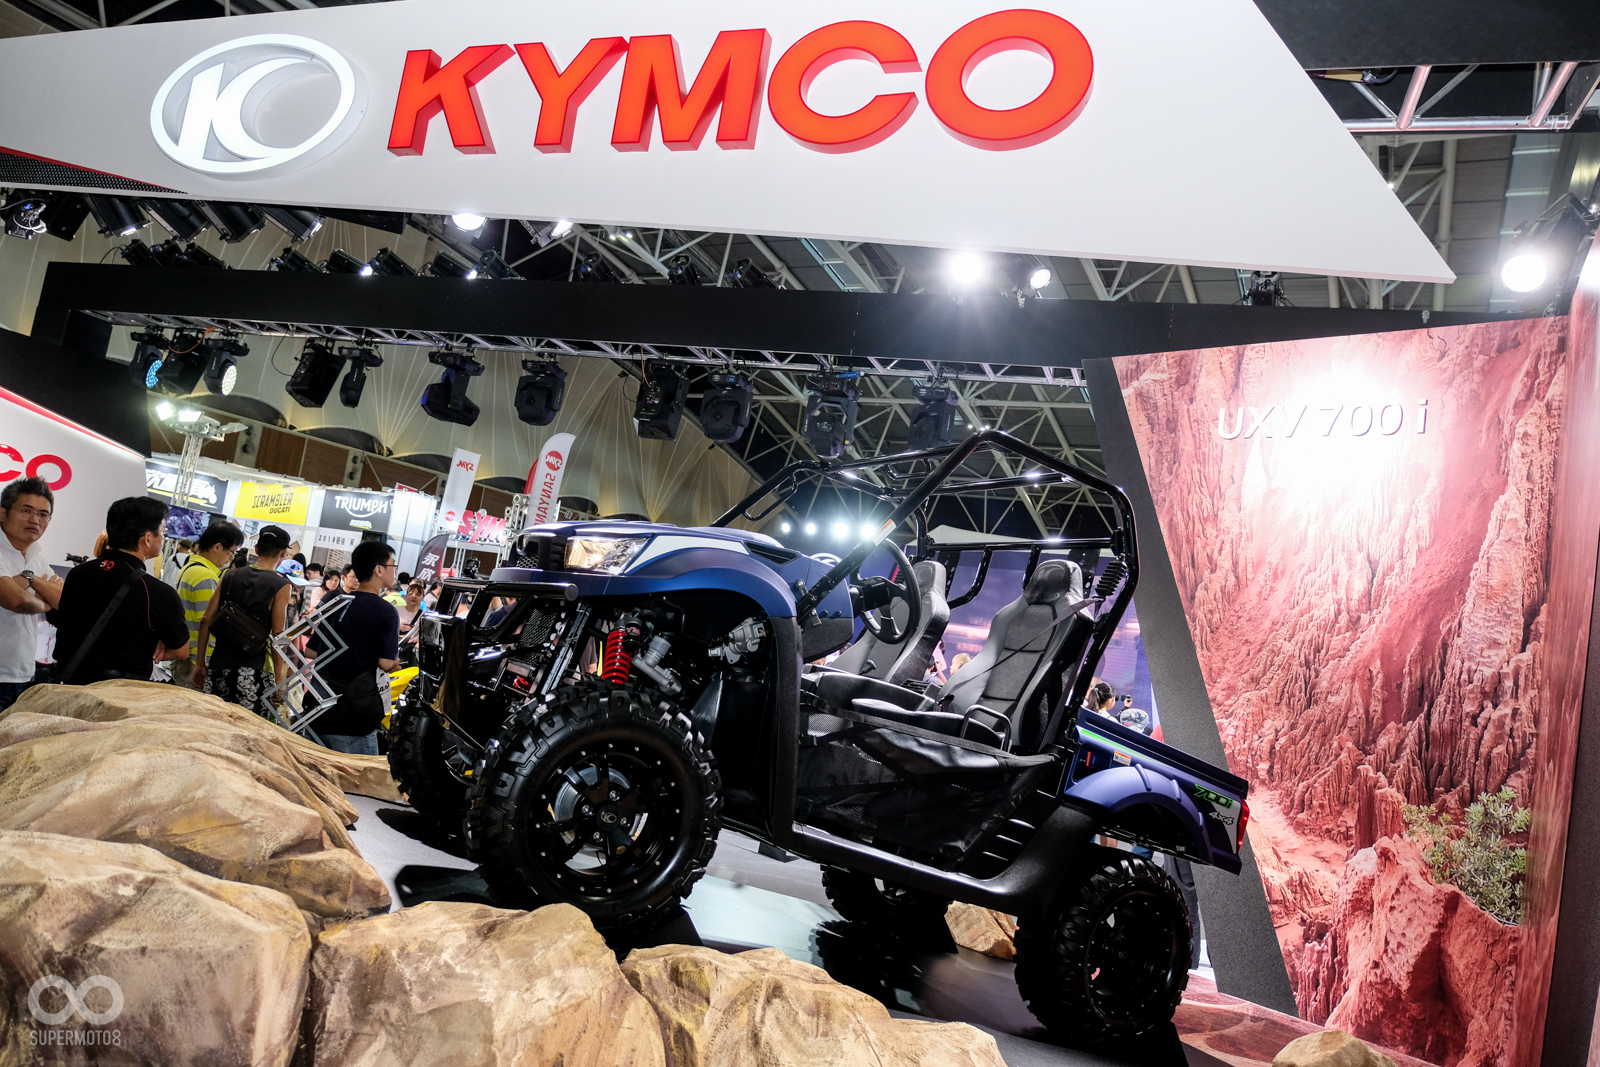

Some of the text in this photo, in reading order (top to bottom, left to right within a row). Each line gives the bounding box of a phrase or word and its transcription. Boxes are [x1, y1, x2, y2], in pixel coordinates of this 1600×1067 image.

[387, 8, 1095, 154] KYMCO
[1217, 405, 1308, 441] UXV
[252, 492, 294, 509] SCRAMBLER
[269, 506, 291, 514] DUCATI
[334, 495, 389, 518] TRIUMPH
[457, 509, 507, 544] SYM
[1193, 783, 1234, 810] 700i
